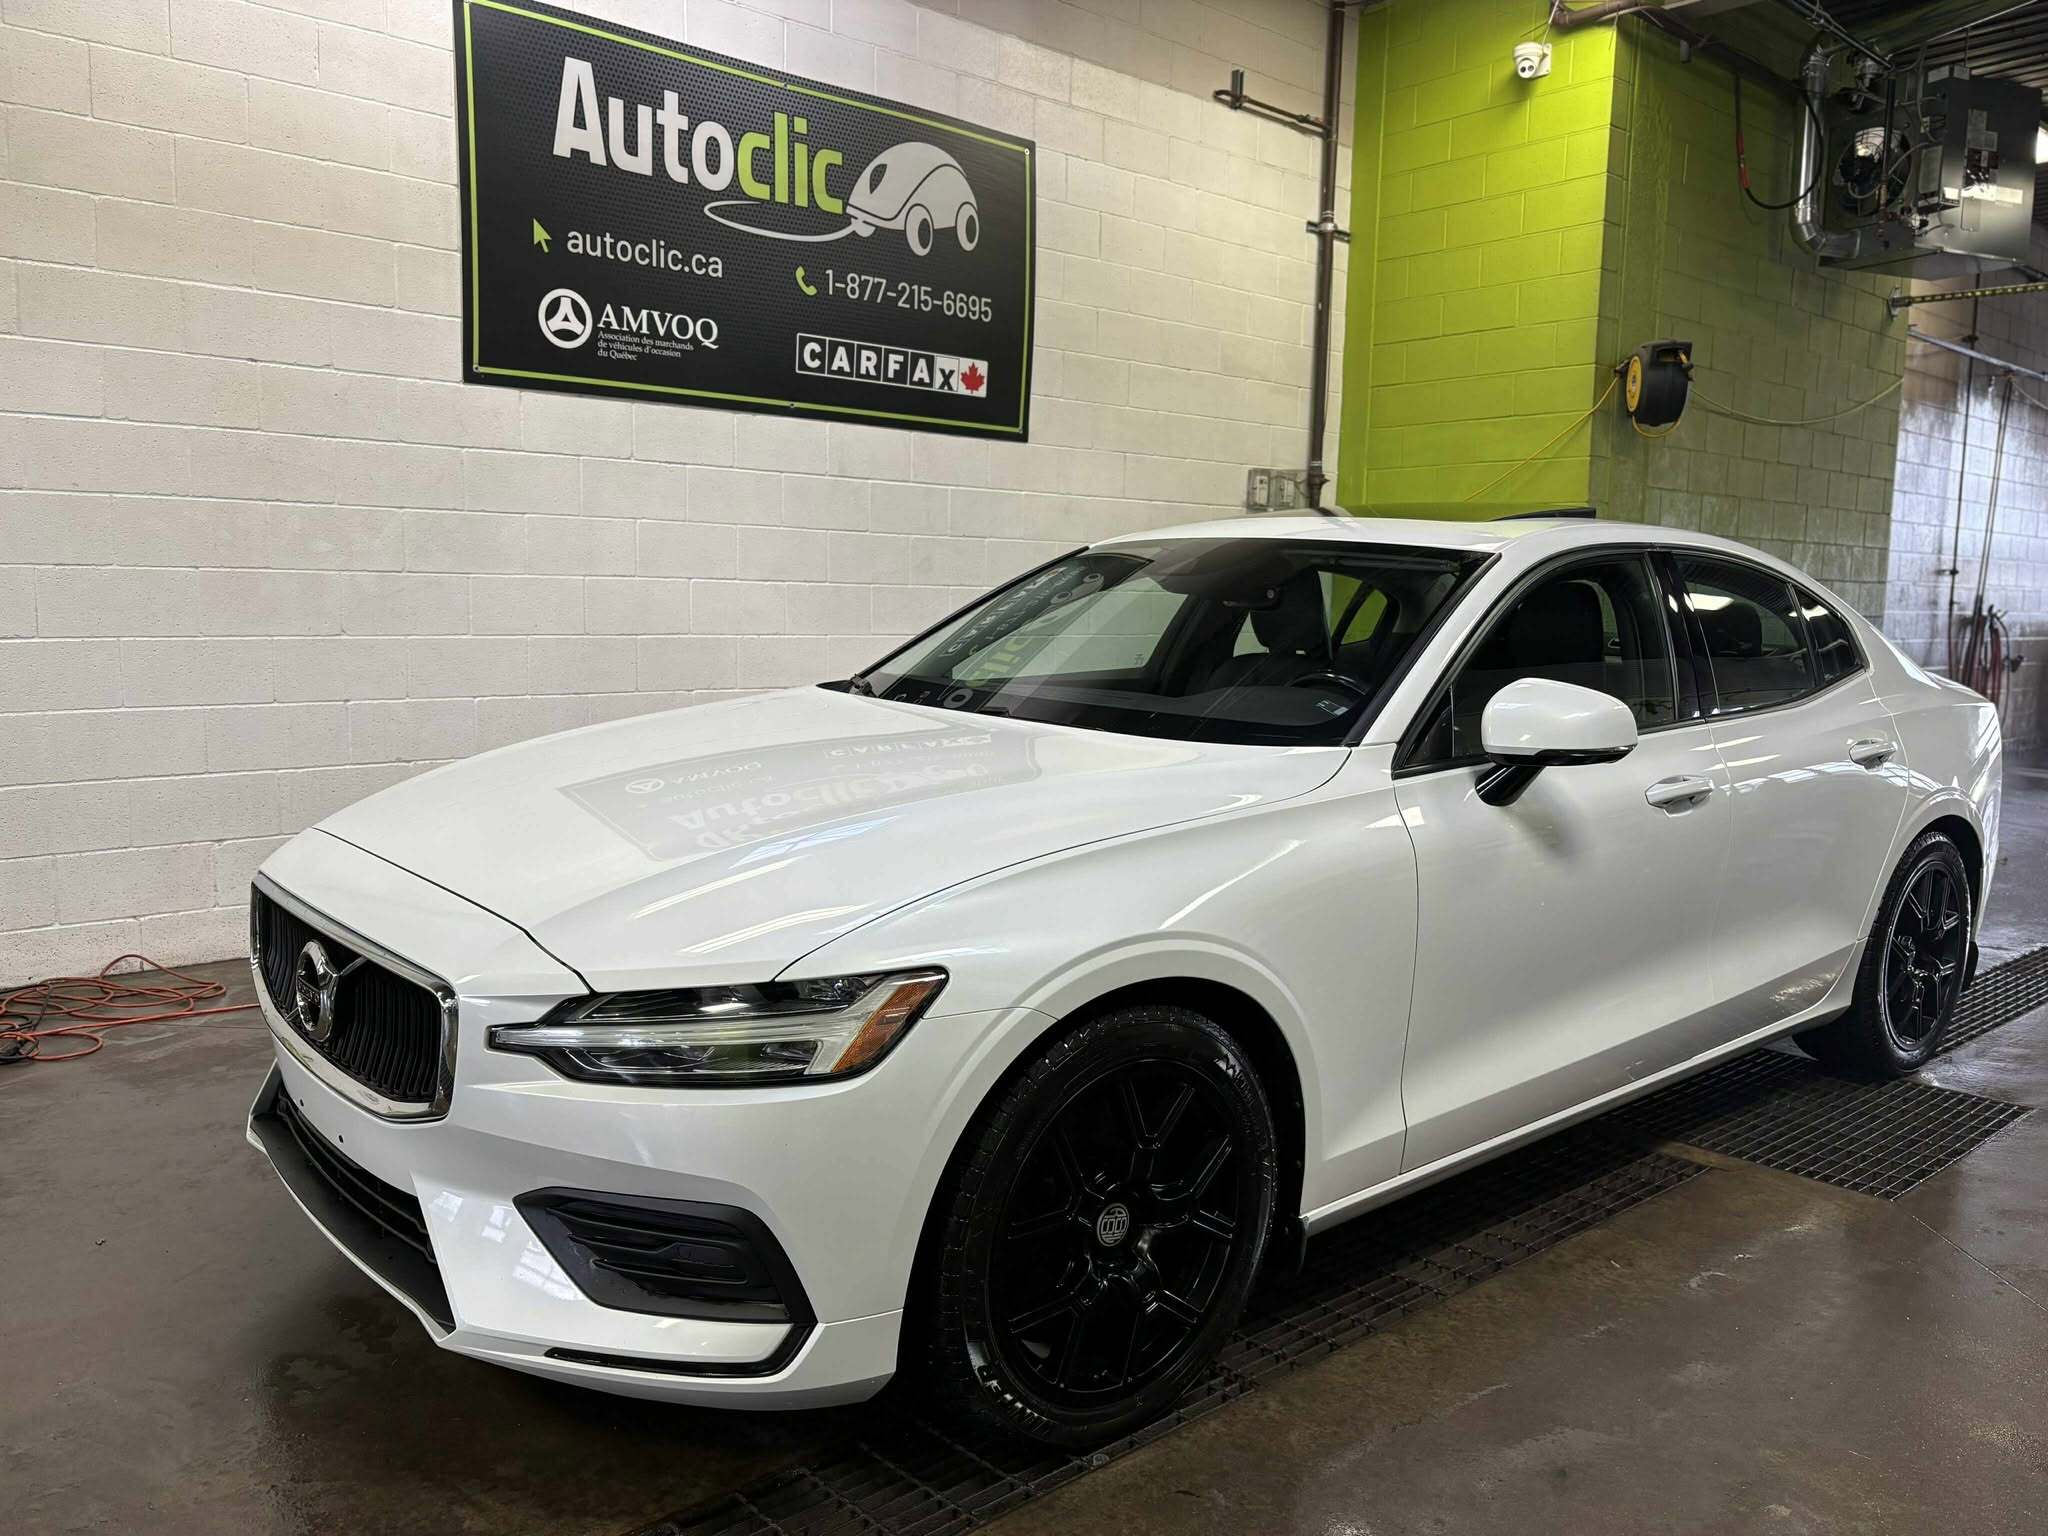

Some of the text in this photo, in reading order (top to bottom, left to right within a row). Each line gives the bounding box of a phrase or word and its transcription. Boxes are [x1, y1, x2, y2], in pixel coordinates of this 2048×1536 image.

[552, 56, 843, 215] Autoclic
[567, 230, 723, 278] autoclic.ca
[825, 269, 992, 322] 1-877-215-6695
[597, 303, 719, 349] AMVOQ
[597, 339, 608, 348] de
[609, 341, 642, 352] véhicules
[598, 330, 694, 351] Association des marchands
[597, 349, 638, 361] du Québec
[803, 342, 956, 392] CARFAX
